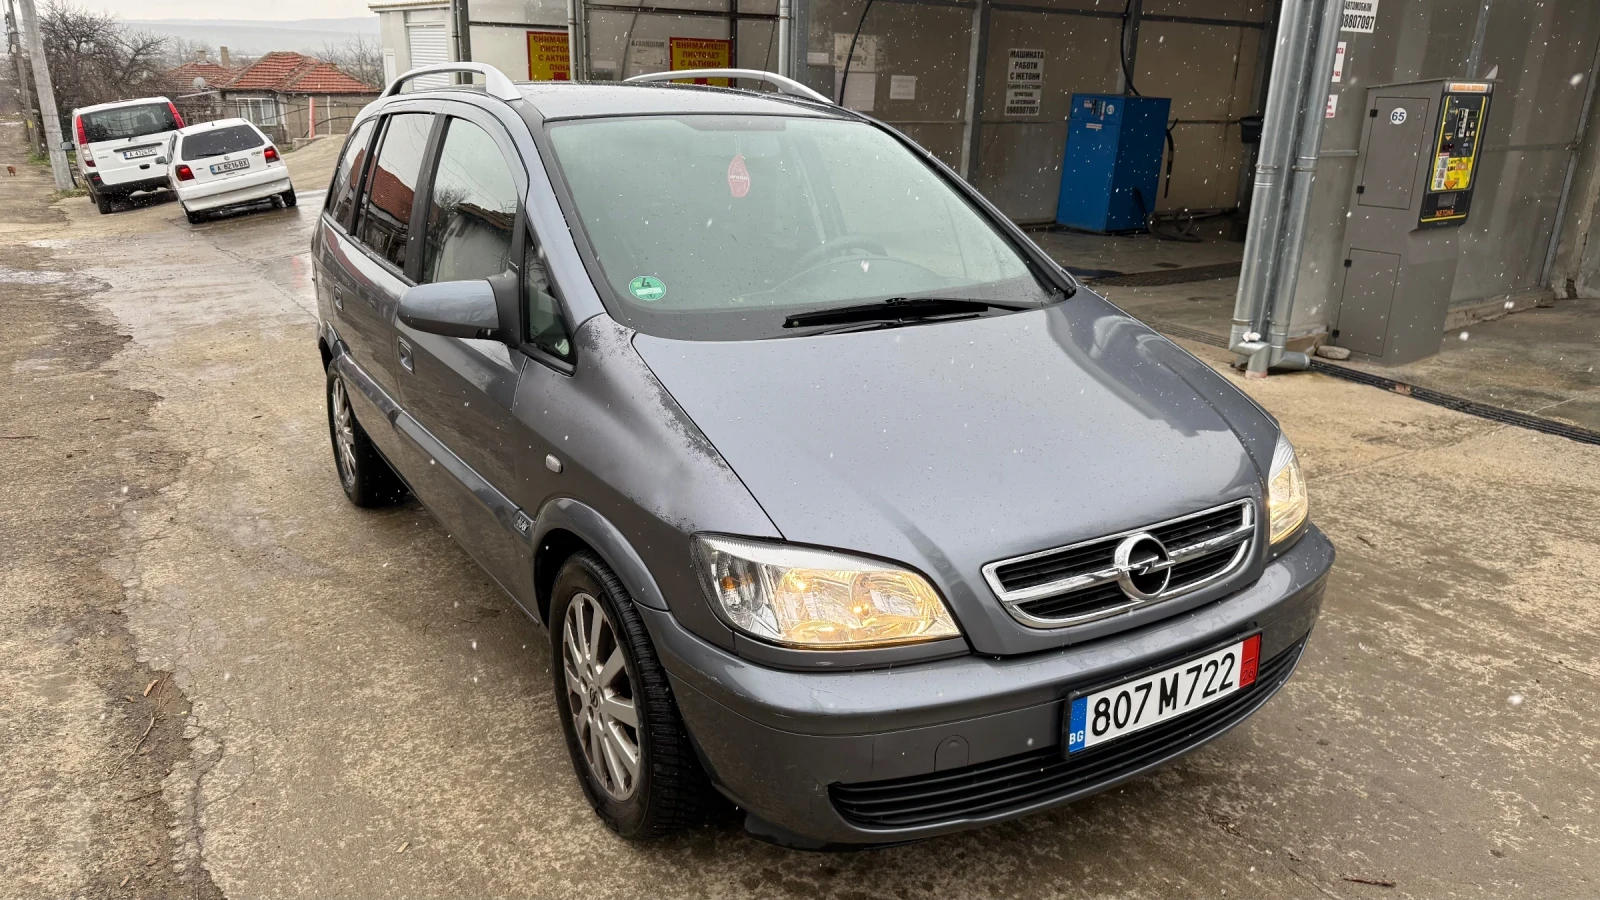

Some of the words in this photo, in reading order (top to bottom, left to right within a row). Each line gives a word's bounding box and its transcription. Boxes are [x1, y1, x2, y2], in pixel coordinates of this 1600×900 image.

[533, 35, 569, 43] ВНИМАН
[682, 51, 720, 59] ПИСТОЛЕТ
[1010, 50, 1044, 59] МАШИНАТА
[687, 60, 722, 68] АКТИВНА
[1014, 61, 1038, 70] РАБОТИ
[1010, 72, 1015, 80] С
[1015, 72, 1041, 80] ЖЕТОНИ
[1391, 111, 1405, 122] 65
[223, 161, 239, 170] 8216
[239, 159, 248, 167] BX
[641, 277, 652, 288] 4
[1069, 730, 1084, 745] BG
[1091, 681, 1153, 737] 807
[1158, 672, 1179, 716] M
[1184, 652, 1236, 706] 722
